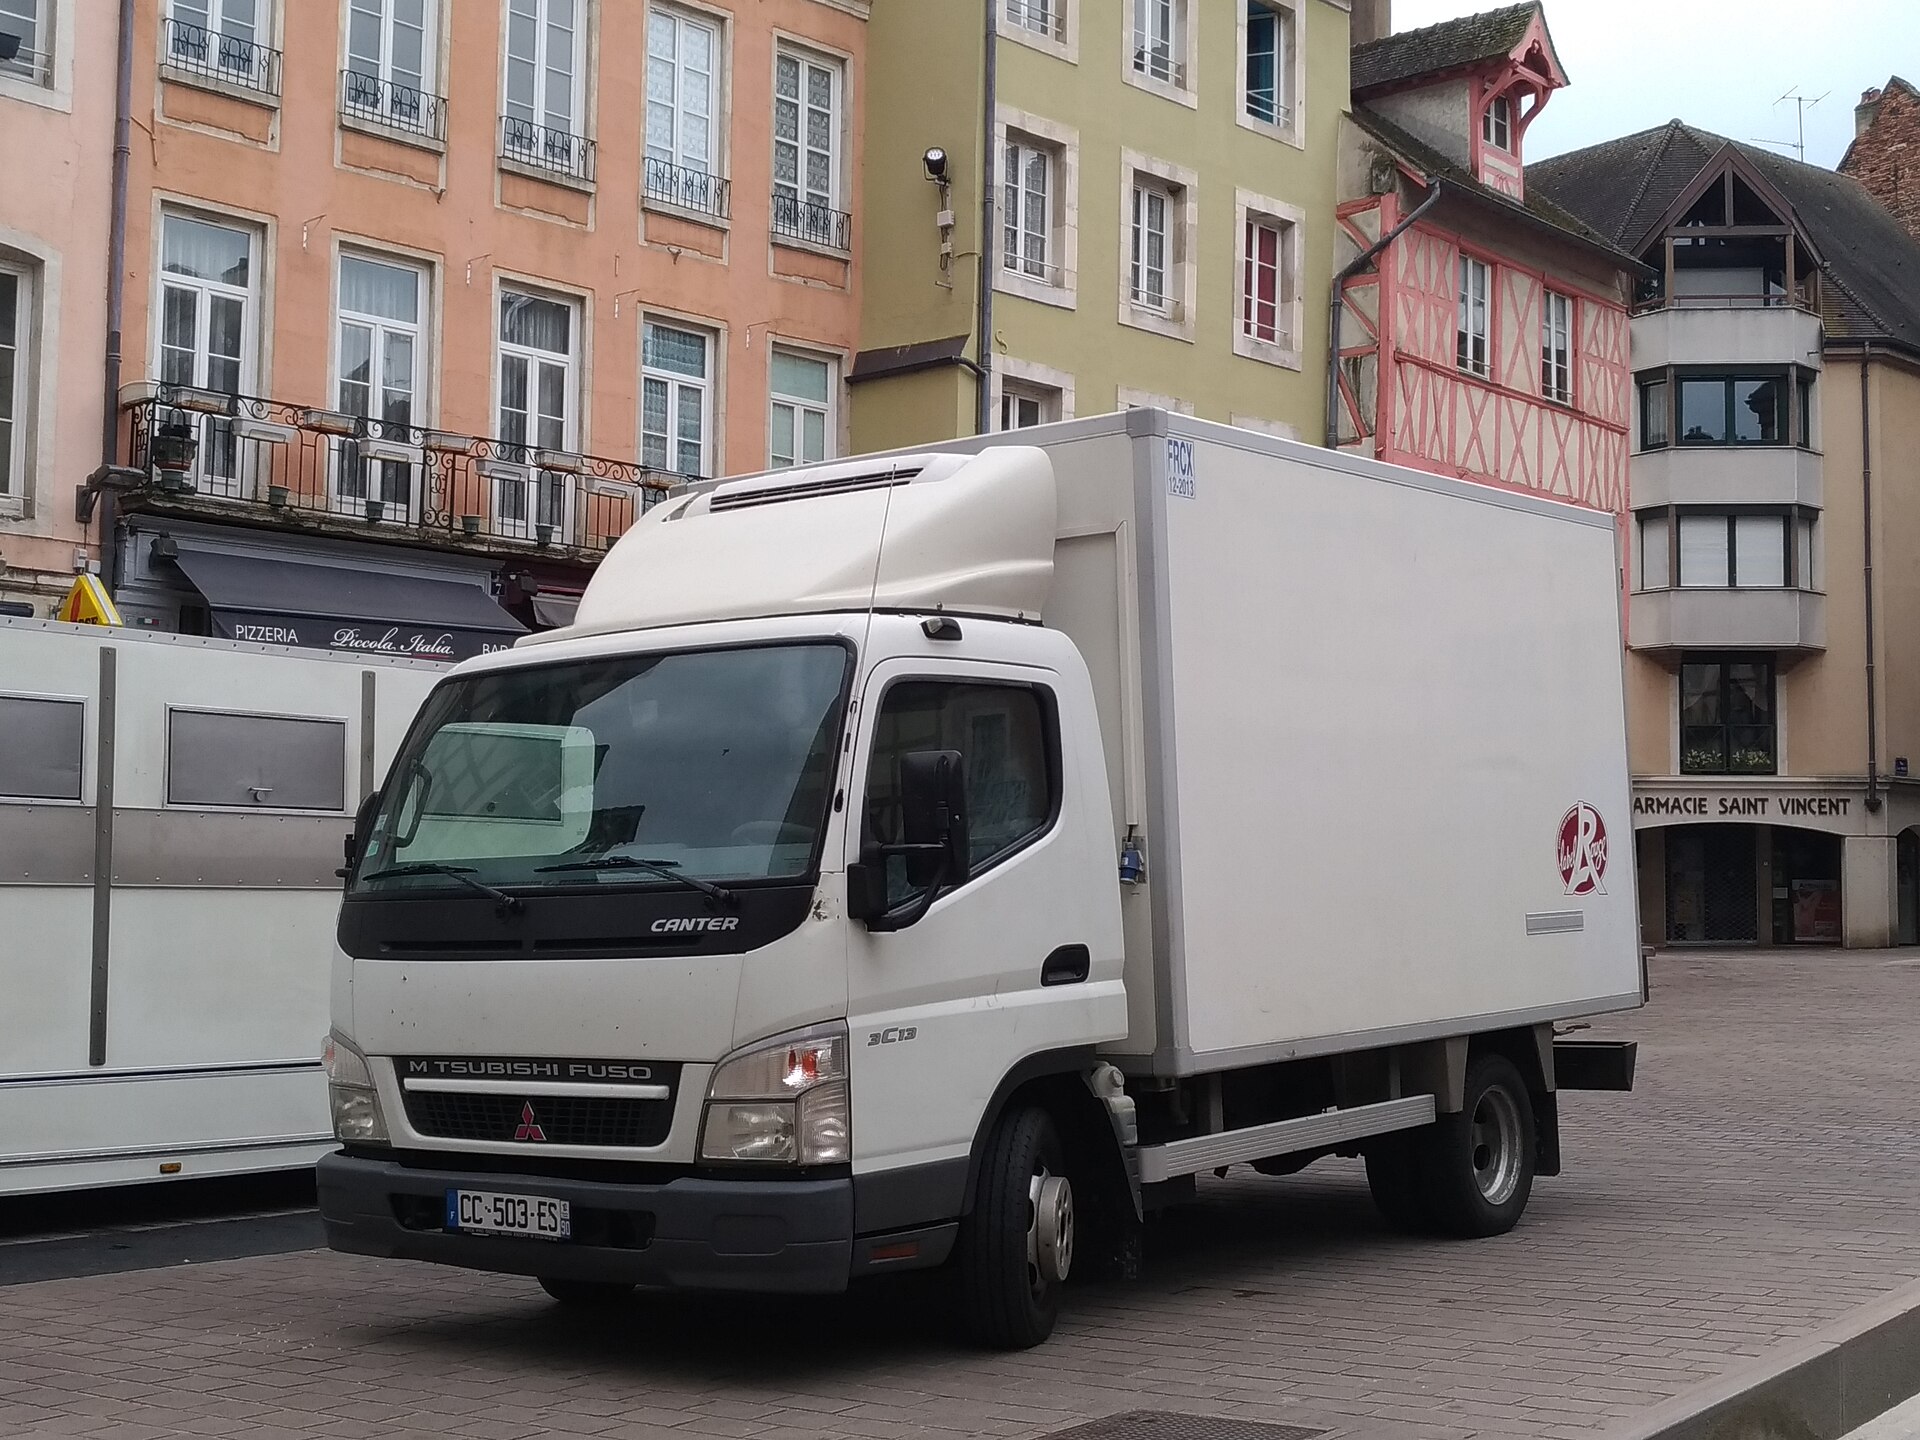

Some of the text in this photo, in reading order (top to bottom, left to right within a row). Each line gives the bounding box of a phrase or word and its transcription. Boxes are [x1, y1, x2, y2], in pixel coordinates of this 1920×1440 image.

[1168, 439, 1193, 477] FRCX
[1168, 476, 1194, 497] 12-2013
[495, 583, 502, 595] 7
[235, 624, 299, 643] PIZZERIA
[330, 627, 454, 654] Piccola Italia
[1718, 797, 1769, 815] SAINT
[1779, 797, 1851, 816] VINCENT
[650, 917, 739, 932] CANTER
[867, 1027, 917, 1047] 3C13
[569, 1064, 651, 1079] FUSO
[560, 1220, 571, 1236] 90
